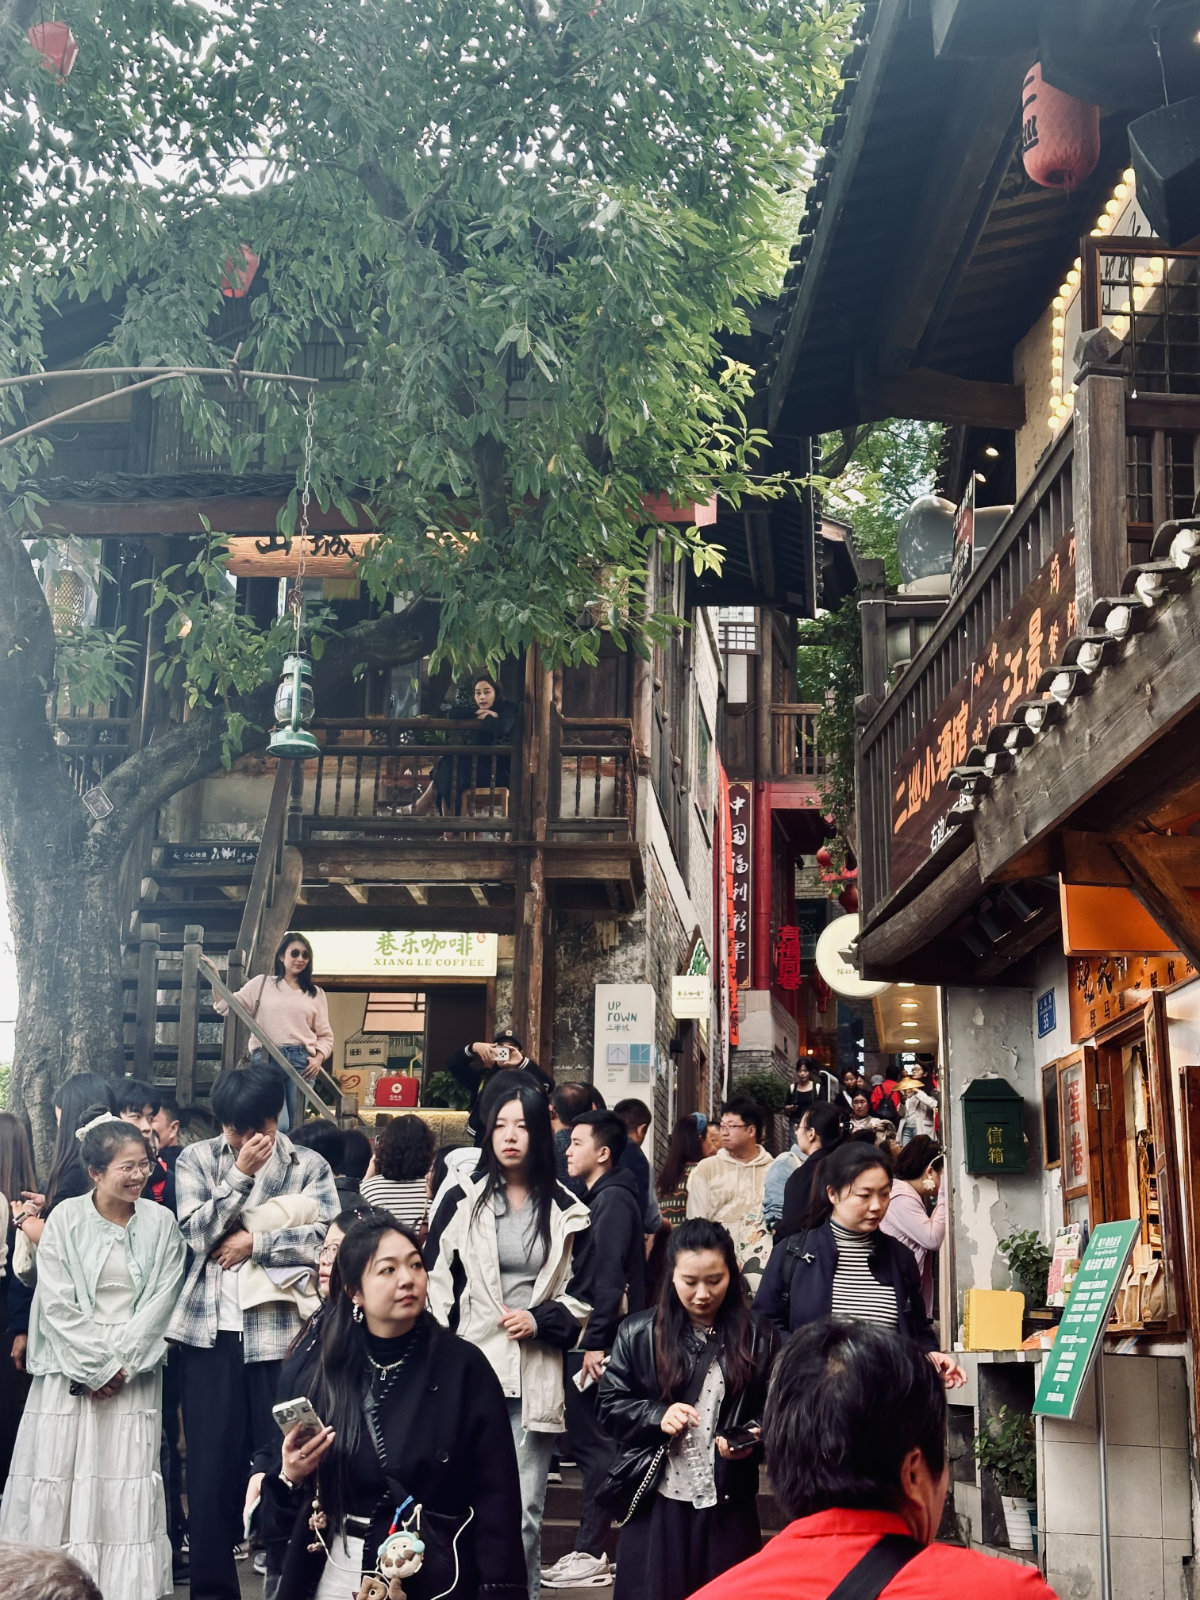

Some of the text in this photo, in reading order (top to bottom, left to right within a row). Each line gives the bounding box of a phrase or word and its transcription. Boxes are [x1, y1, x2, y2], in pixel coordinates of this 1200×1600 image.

[374, 929, 473, 956] 巷乐咖啡
[374, 958, 485, 967] XIANG LE COFFEE
[608, 1001, 621, 1011] UP
[987, 1126, 1004, 1164] 信箱
